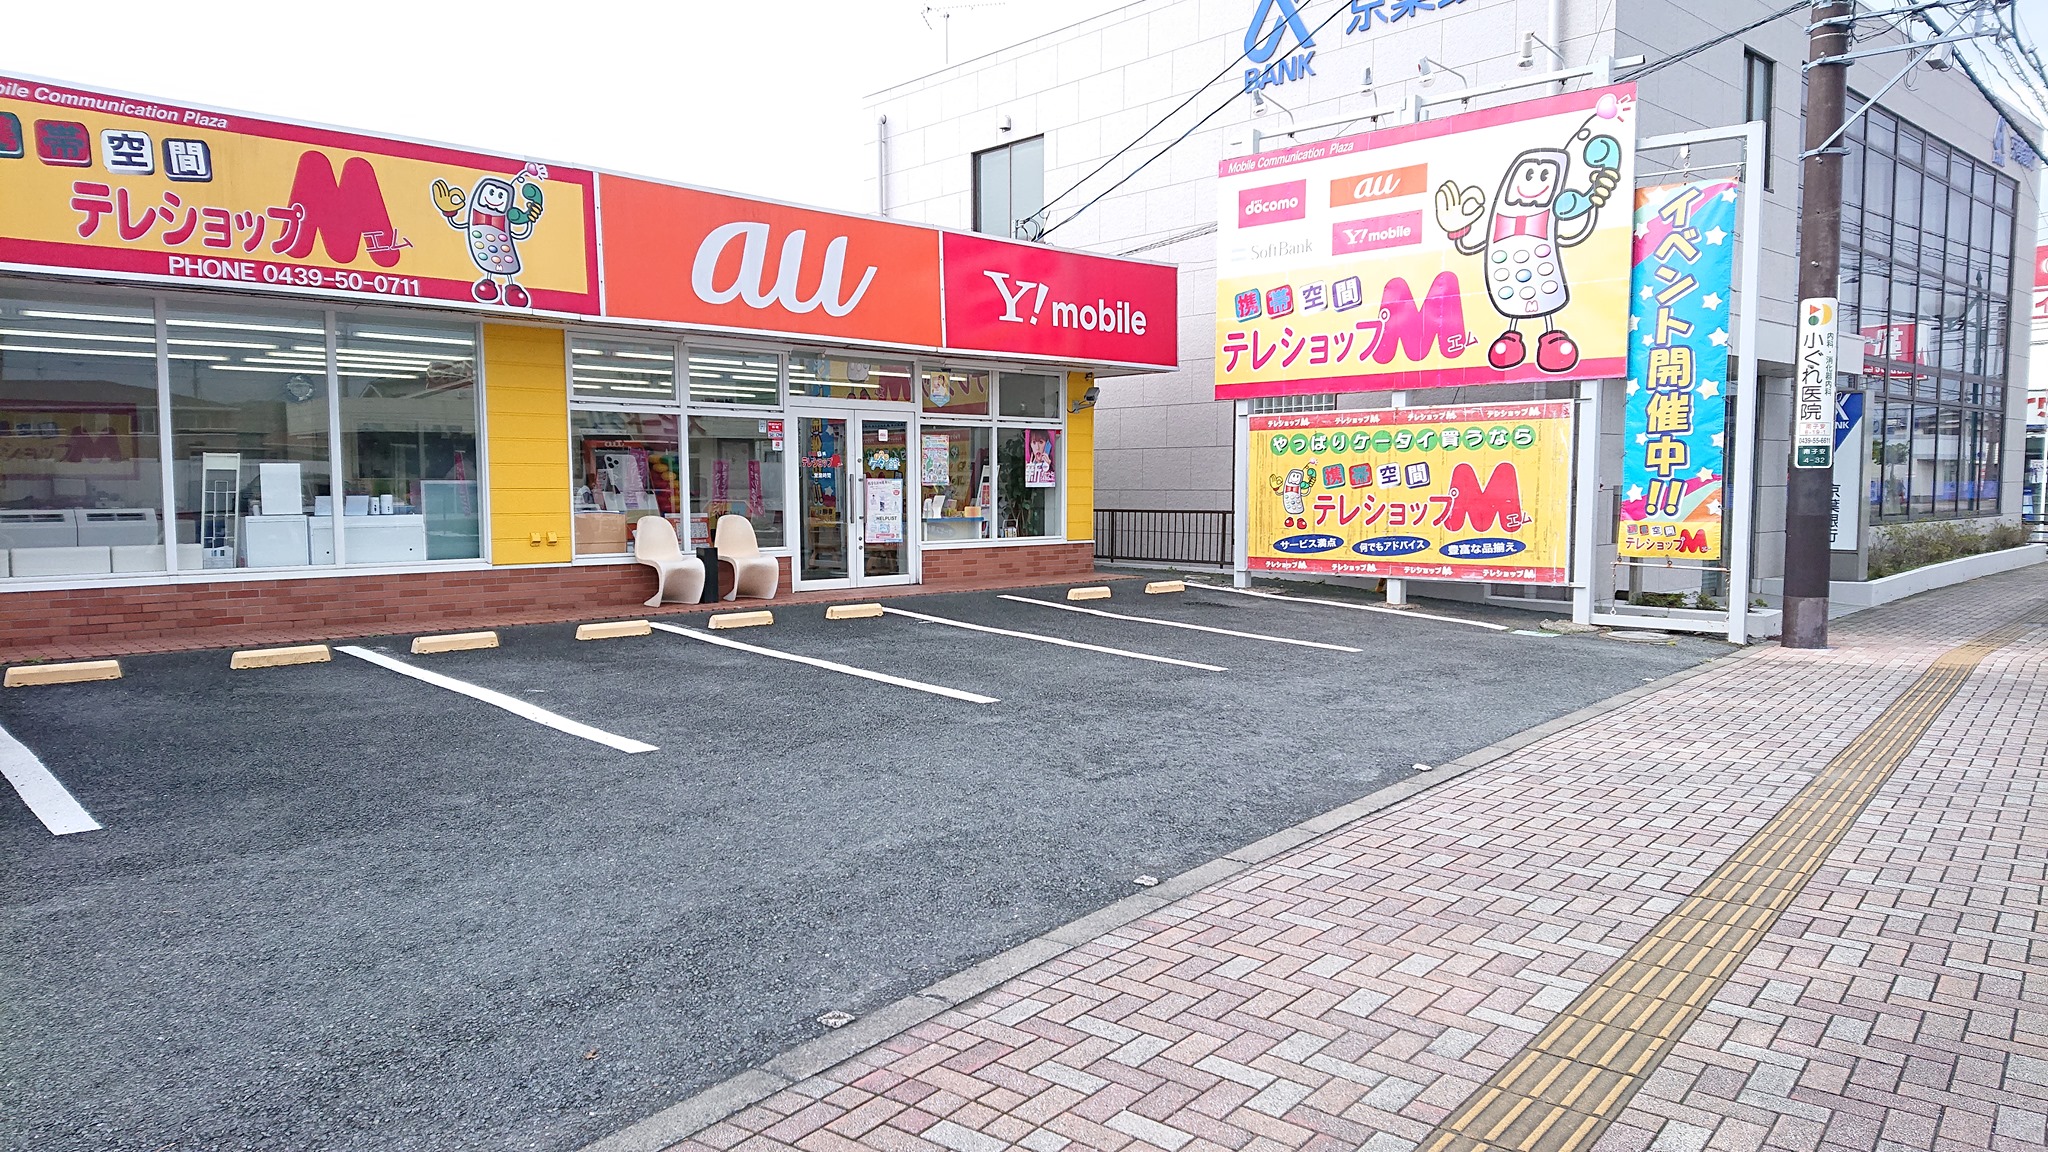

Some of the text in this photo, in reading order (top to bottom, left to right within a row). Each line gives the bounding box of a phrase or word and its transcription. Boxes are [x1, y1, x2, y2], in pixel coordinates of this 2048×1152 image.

[1244, 50, 1316, 94] BANK
[34, 86, 178, 122] Communication
[183, 110, 228, 129] Plaza
[1228, 141, 1354, 174] Mobile Communication Plaza
[1353, 173, 1400, 199] au
[1245, 196, 1299, 215] docomo
[362, 227, 413, 251] エム
[1251, 238, 1313, 260] SoftBank
[168, 254, 420, 296] PHONE 0439-50-0711
[690, 221, 878, 317] au
[1236, 278, 1361, 322] 携帯空間
[1447, 331, 1479, 352] エム
[1801, 332, 1824, 420] 小ぐれ医院
[1272, 428, 1535, 454] やっぱりケータイ買うなら
[1323, 462, 1429, 489] 携帯空間
[1280, 538, 1337, 550] サービス満点
[1359, 539, 1425, 552] 何でもアドバイス
[1447, 542, 1518, 556] 豊富な品揃え
